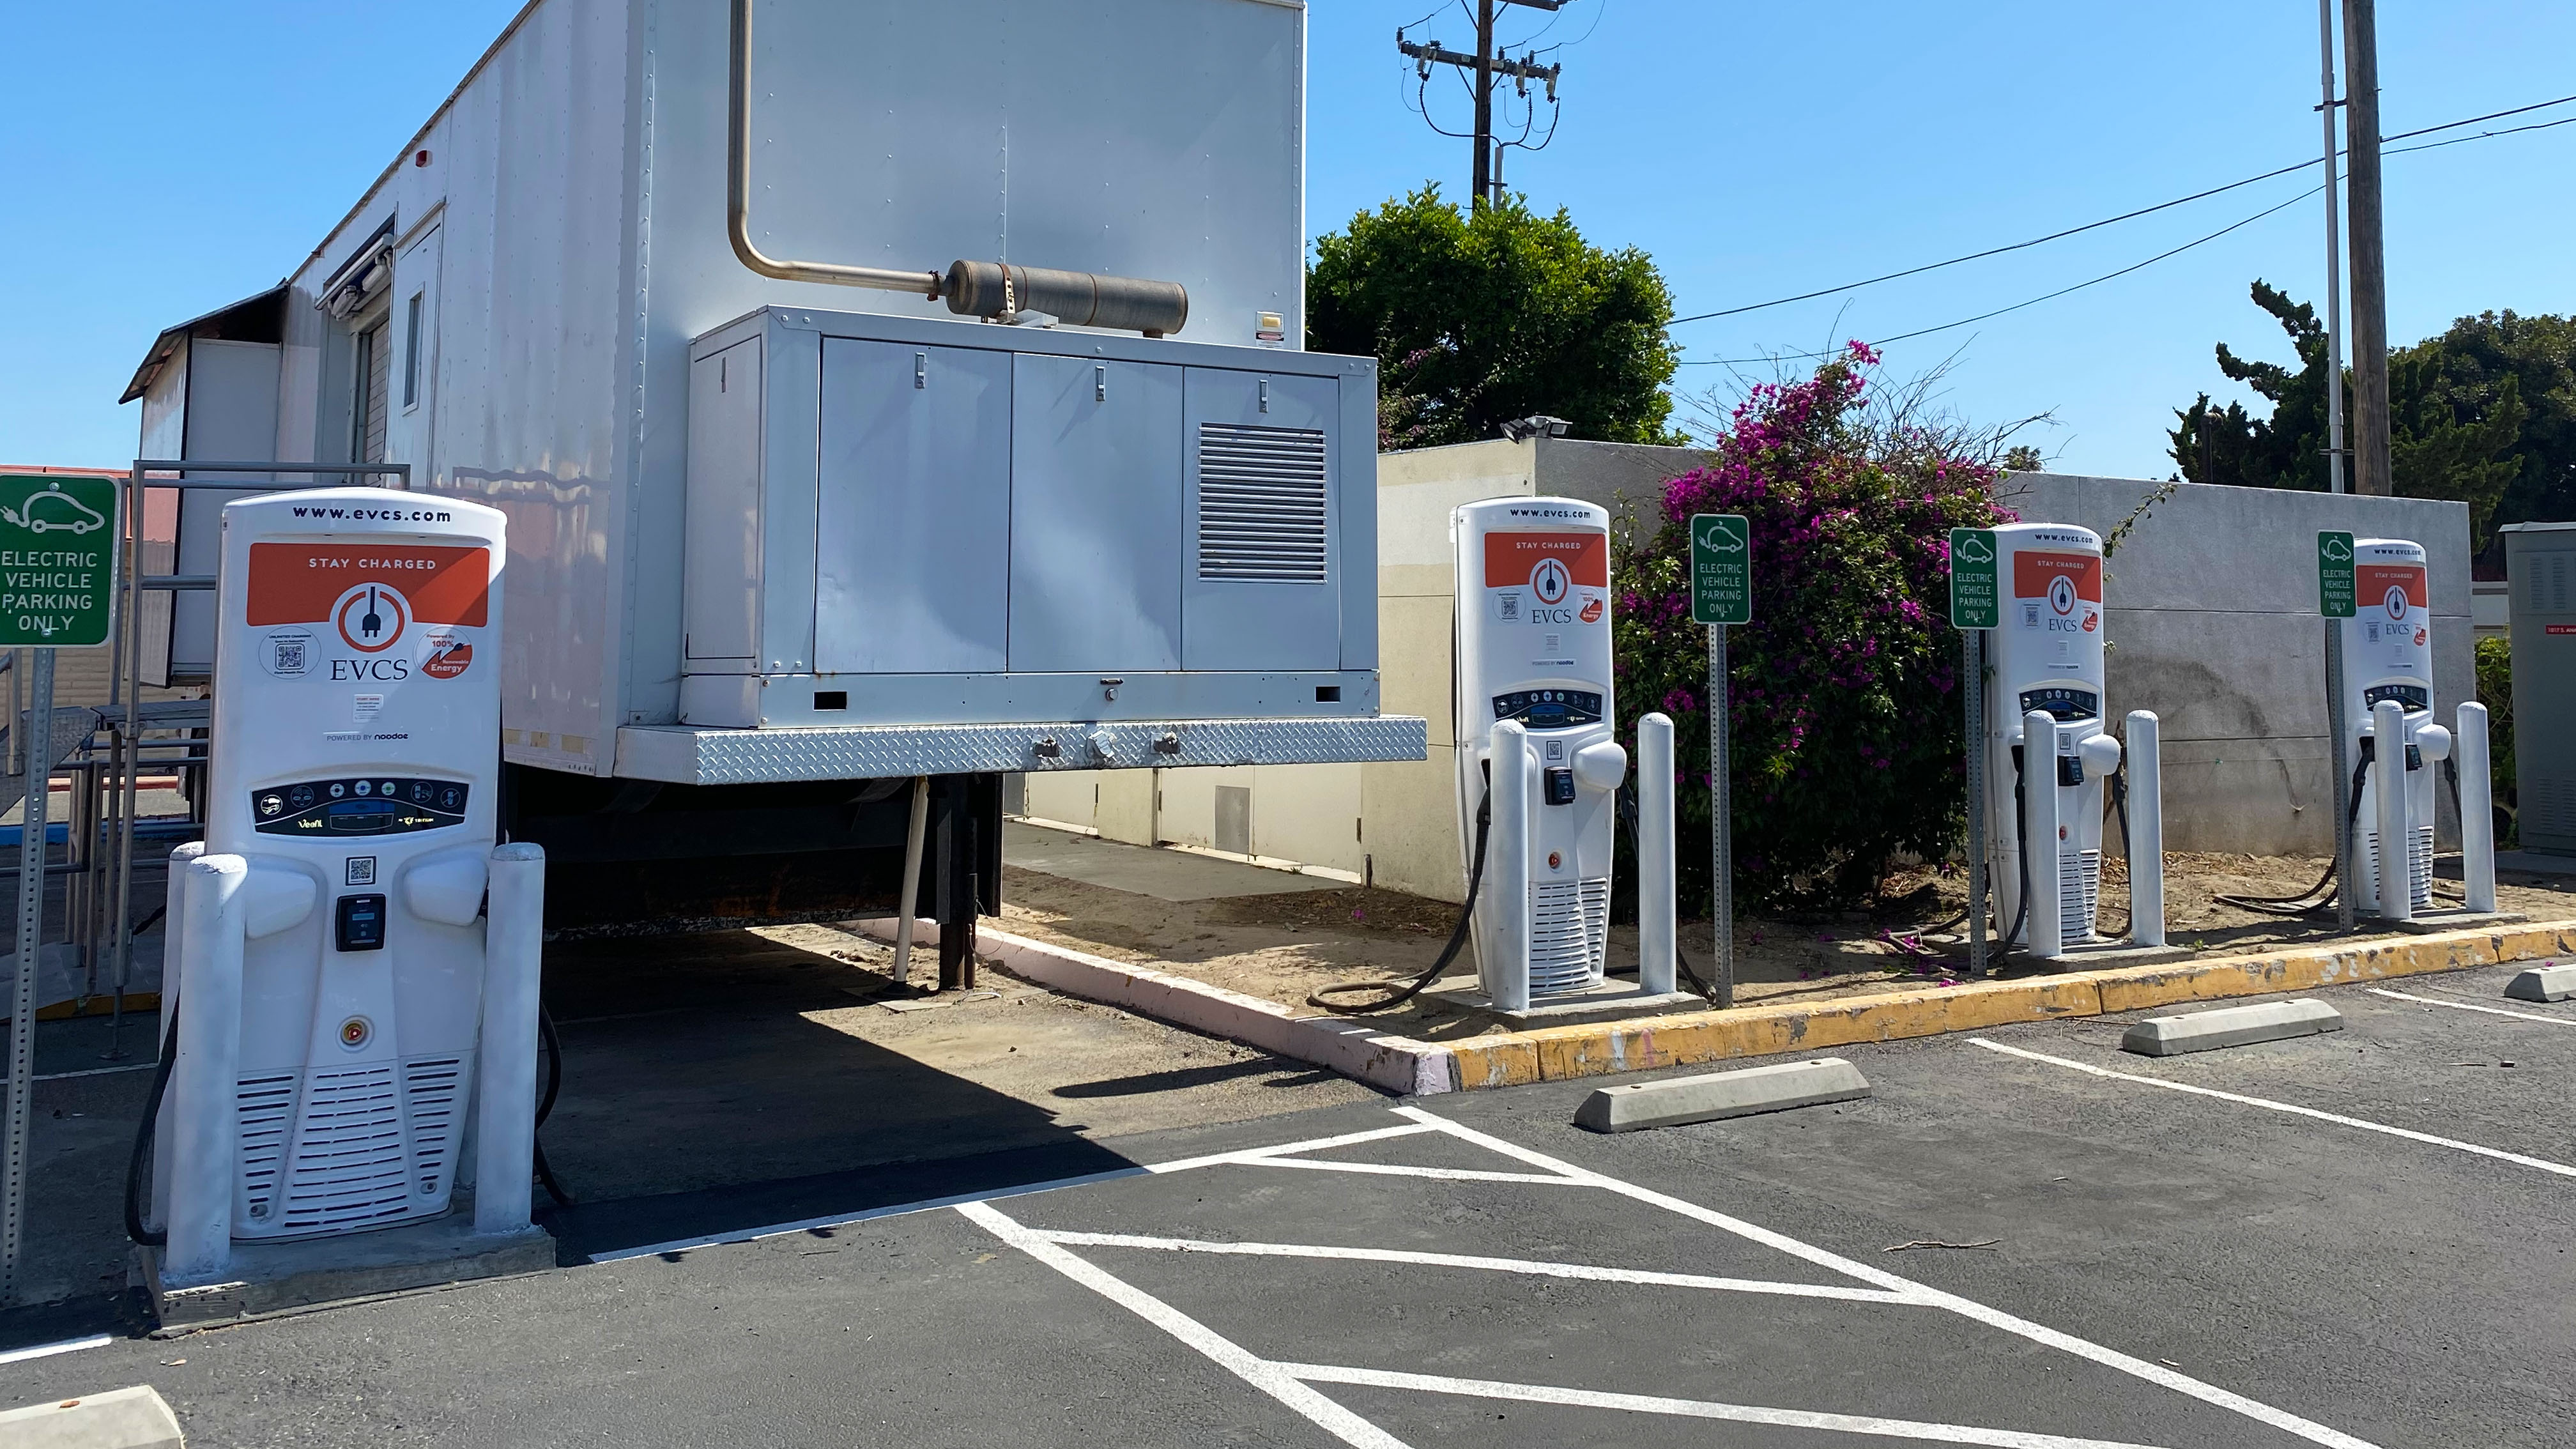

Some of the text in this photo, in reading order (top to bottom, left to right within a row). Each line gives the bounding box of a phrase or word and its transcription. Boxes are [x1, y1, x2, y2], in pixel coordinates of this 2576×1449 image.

[293, 507, 450, 522] www.evcs.com
[1510, 509, 1591, 519] www.evcs.com
[2035, 534, 2094, 544] www.evcs.com
[1, 551, 98, 567] ELECTRIC
[309, 558, 436, 570] STAY CHARGED
[1699, 563, 1742, 574] ELECTRIC
[2323, 569, 2351, 578] ELECTRIC
[5, 572, 92, 588] VEHICLE
[1702, 576, 1741, 586] VEHICLE
[1957, 572, 1992, 583] ELECTRIC
[2324, 580, 2350, 588] VEHICLE
[1701, 590, 1742, 600] PARKING
[1959, 585, 1991, 595] VEHICLE
[2324, 591, 2351, 599] PARKING
[2, 594, 93, 610] PARKING
[1958, 597, 1992, 607] PARKING
[2330, 602, 2347, 610] ONLY
[1709, 603, 1734, 613] ONLY
[1531, 609, 1572, 624] EVCS
[1965, 610, 1986, 619] ONLY
[18, 615, 75, 631] ONLY
[2049, 618, 2077, 632] EVCS
[2386, 624, 2409, 634] EVCS
[330, 659, 408, 680] EVCS
[431, 664, 463, 673] Energy
